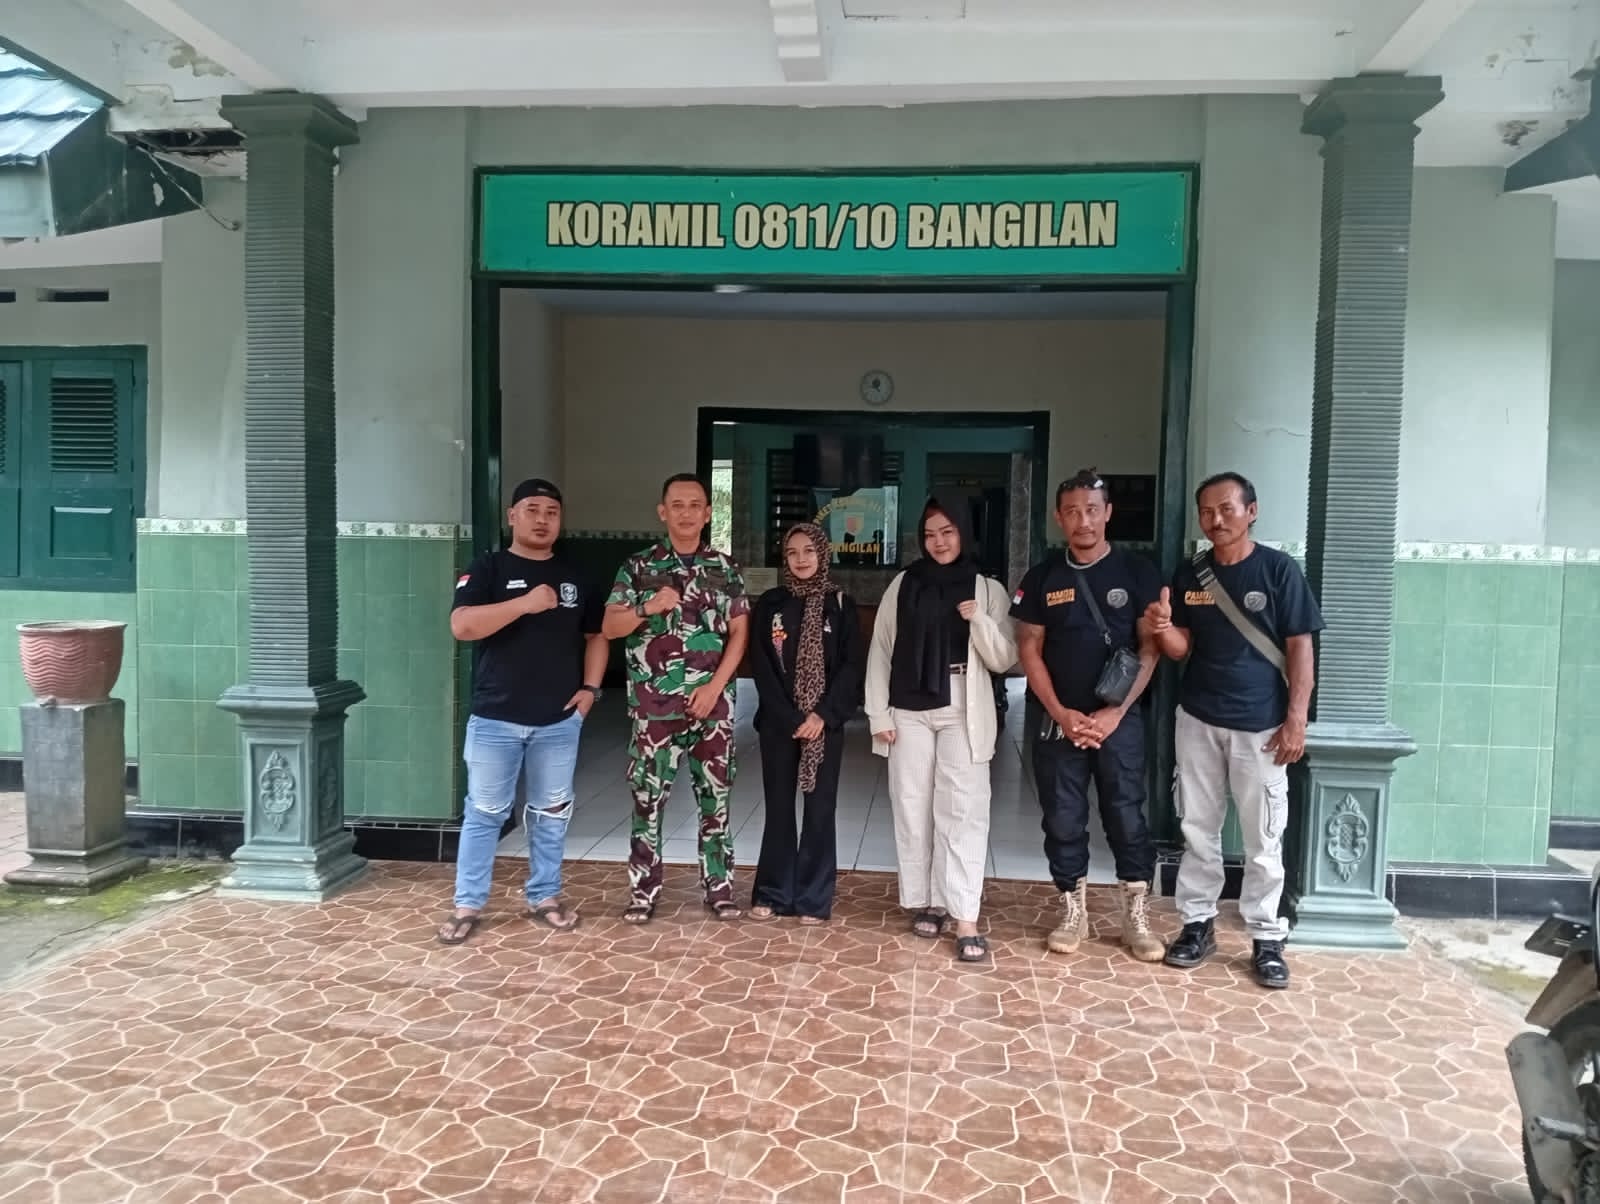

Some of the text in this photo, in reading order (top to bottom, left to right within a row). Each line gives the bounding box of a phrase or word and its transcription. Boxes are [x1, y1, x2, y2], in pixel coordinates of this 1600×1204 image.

[547, 200, 1118, 250] KORAMIL 0811/10 BANGILAN
